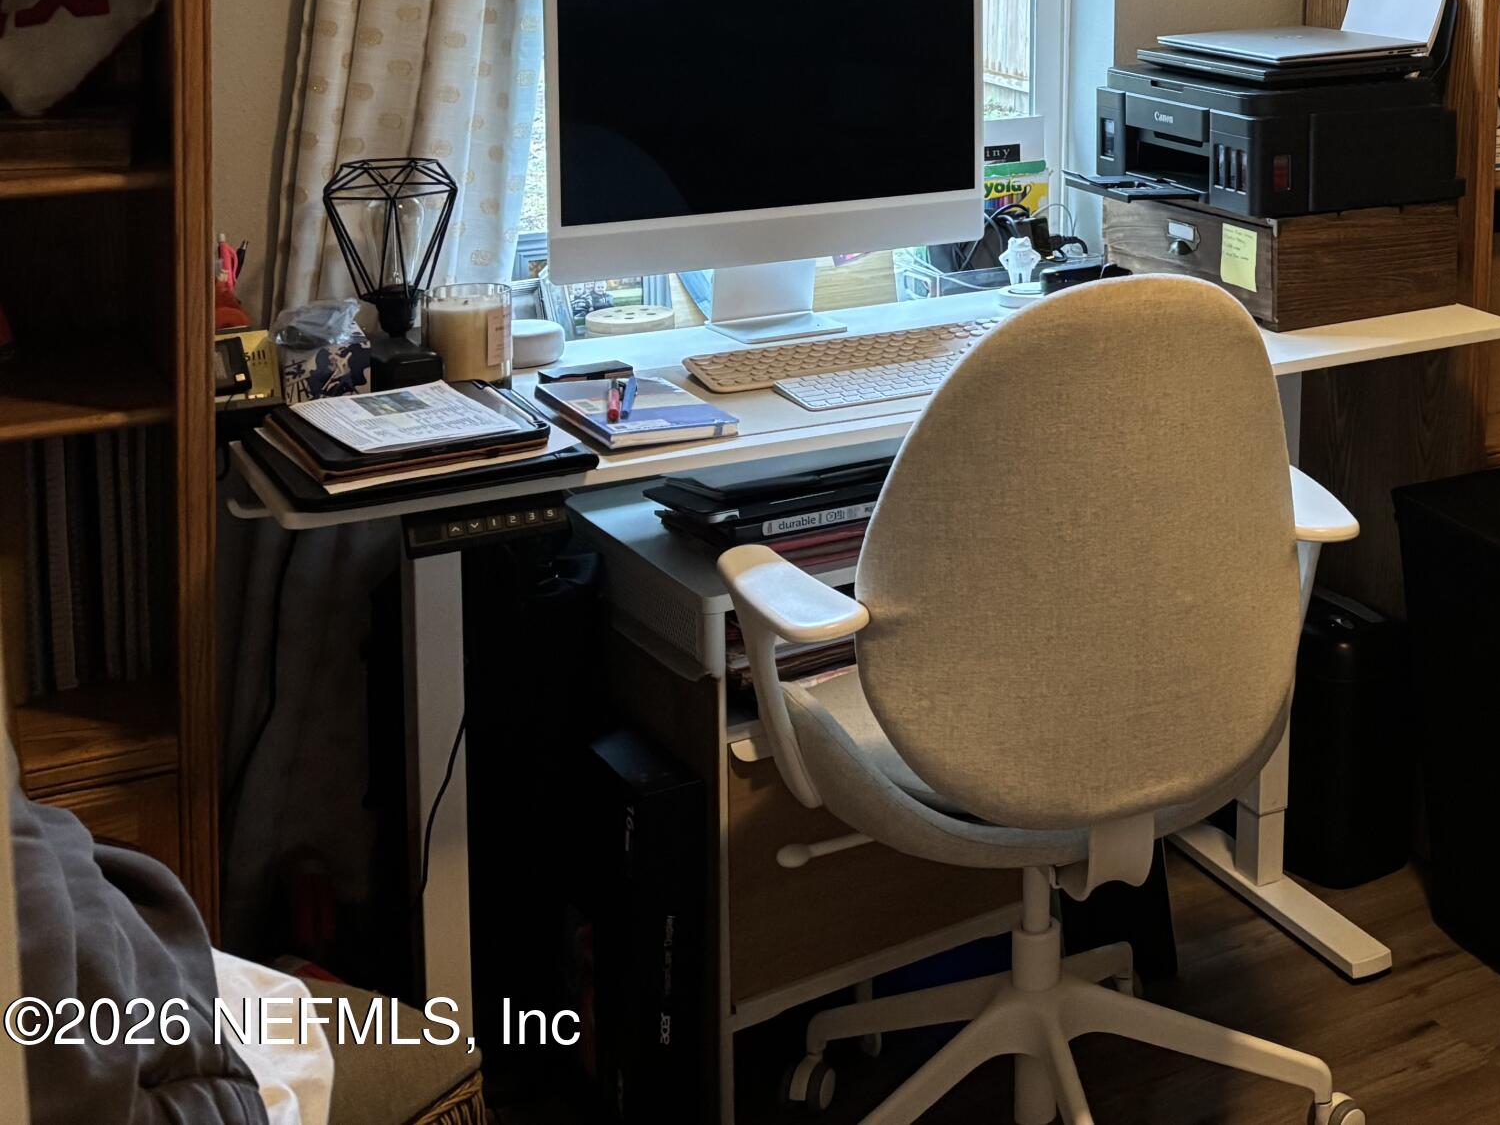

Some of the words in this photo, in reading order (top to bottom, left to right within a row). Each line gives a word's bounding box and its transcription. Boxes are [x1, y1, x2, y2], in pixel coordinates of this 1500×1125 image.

[1154, 110, 1174, 124] Canon
[778, 515, 817, 531] durable
[659, 1012, 672, 1046] acer
